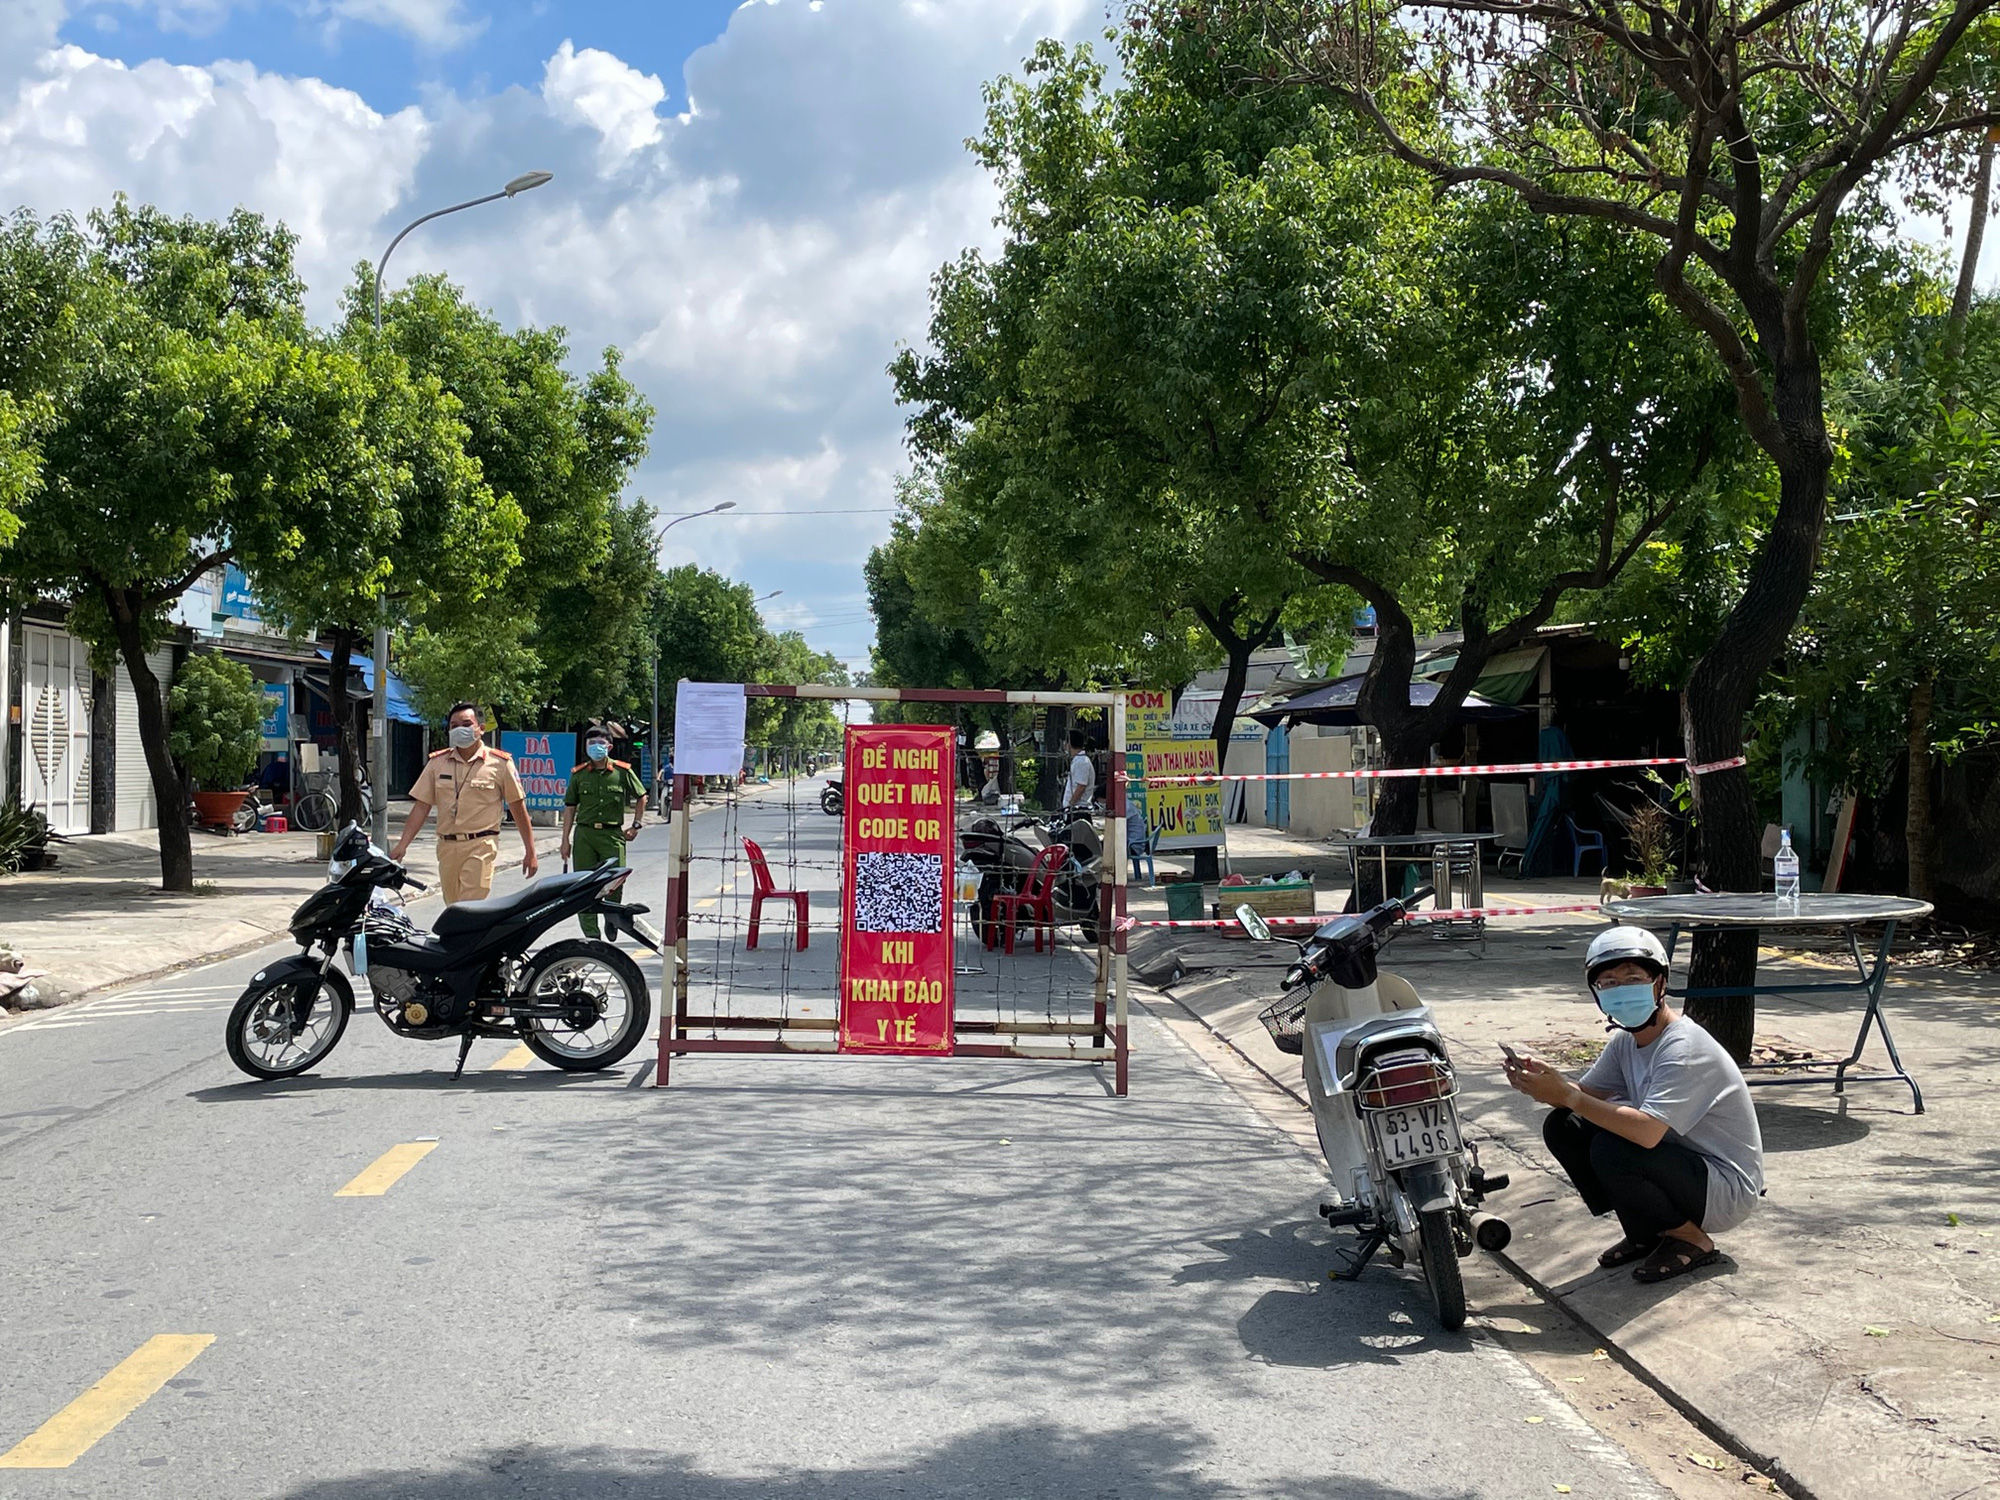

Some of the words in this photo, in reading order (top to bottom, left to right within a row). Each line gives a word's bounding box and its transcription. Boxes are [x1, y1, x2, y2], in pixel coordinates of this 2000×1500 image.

[525, 734, 551, 755] ĐÁ
[862, 741, 887, 769] ĐỀ
[893, 749, 938, 774] NGHỊ
[519, 757, 556, 775] HOA
[858, 779, 906, 806] QUÉT
[911, 781, 942, 805] MÃ
[859, 818, 909, 839] CODE
[914, 819, 940, 842] QR
[881, 941, 914, 964] KHI
[851, 979, 898, 1002] KHAI
[903, 976, 943, 1004] BÁO
[876, 1019, 890, 1042] Y
[894, 1012, 918, 1042] TẾ
[1386, 1104, 1438, 1135] 53-V7
[1393, 1129, 1449, 1160] 4496
